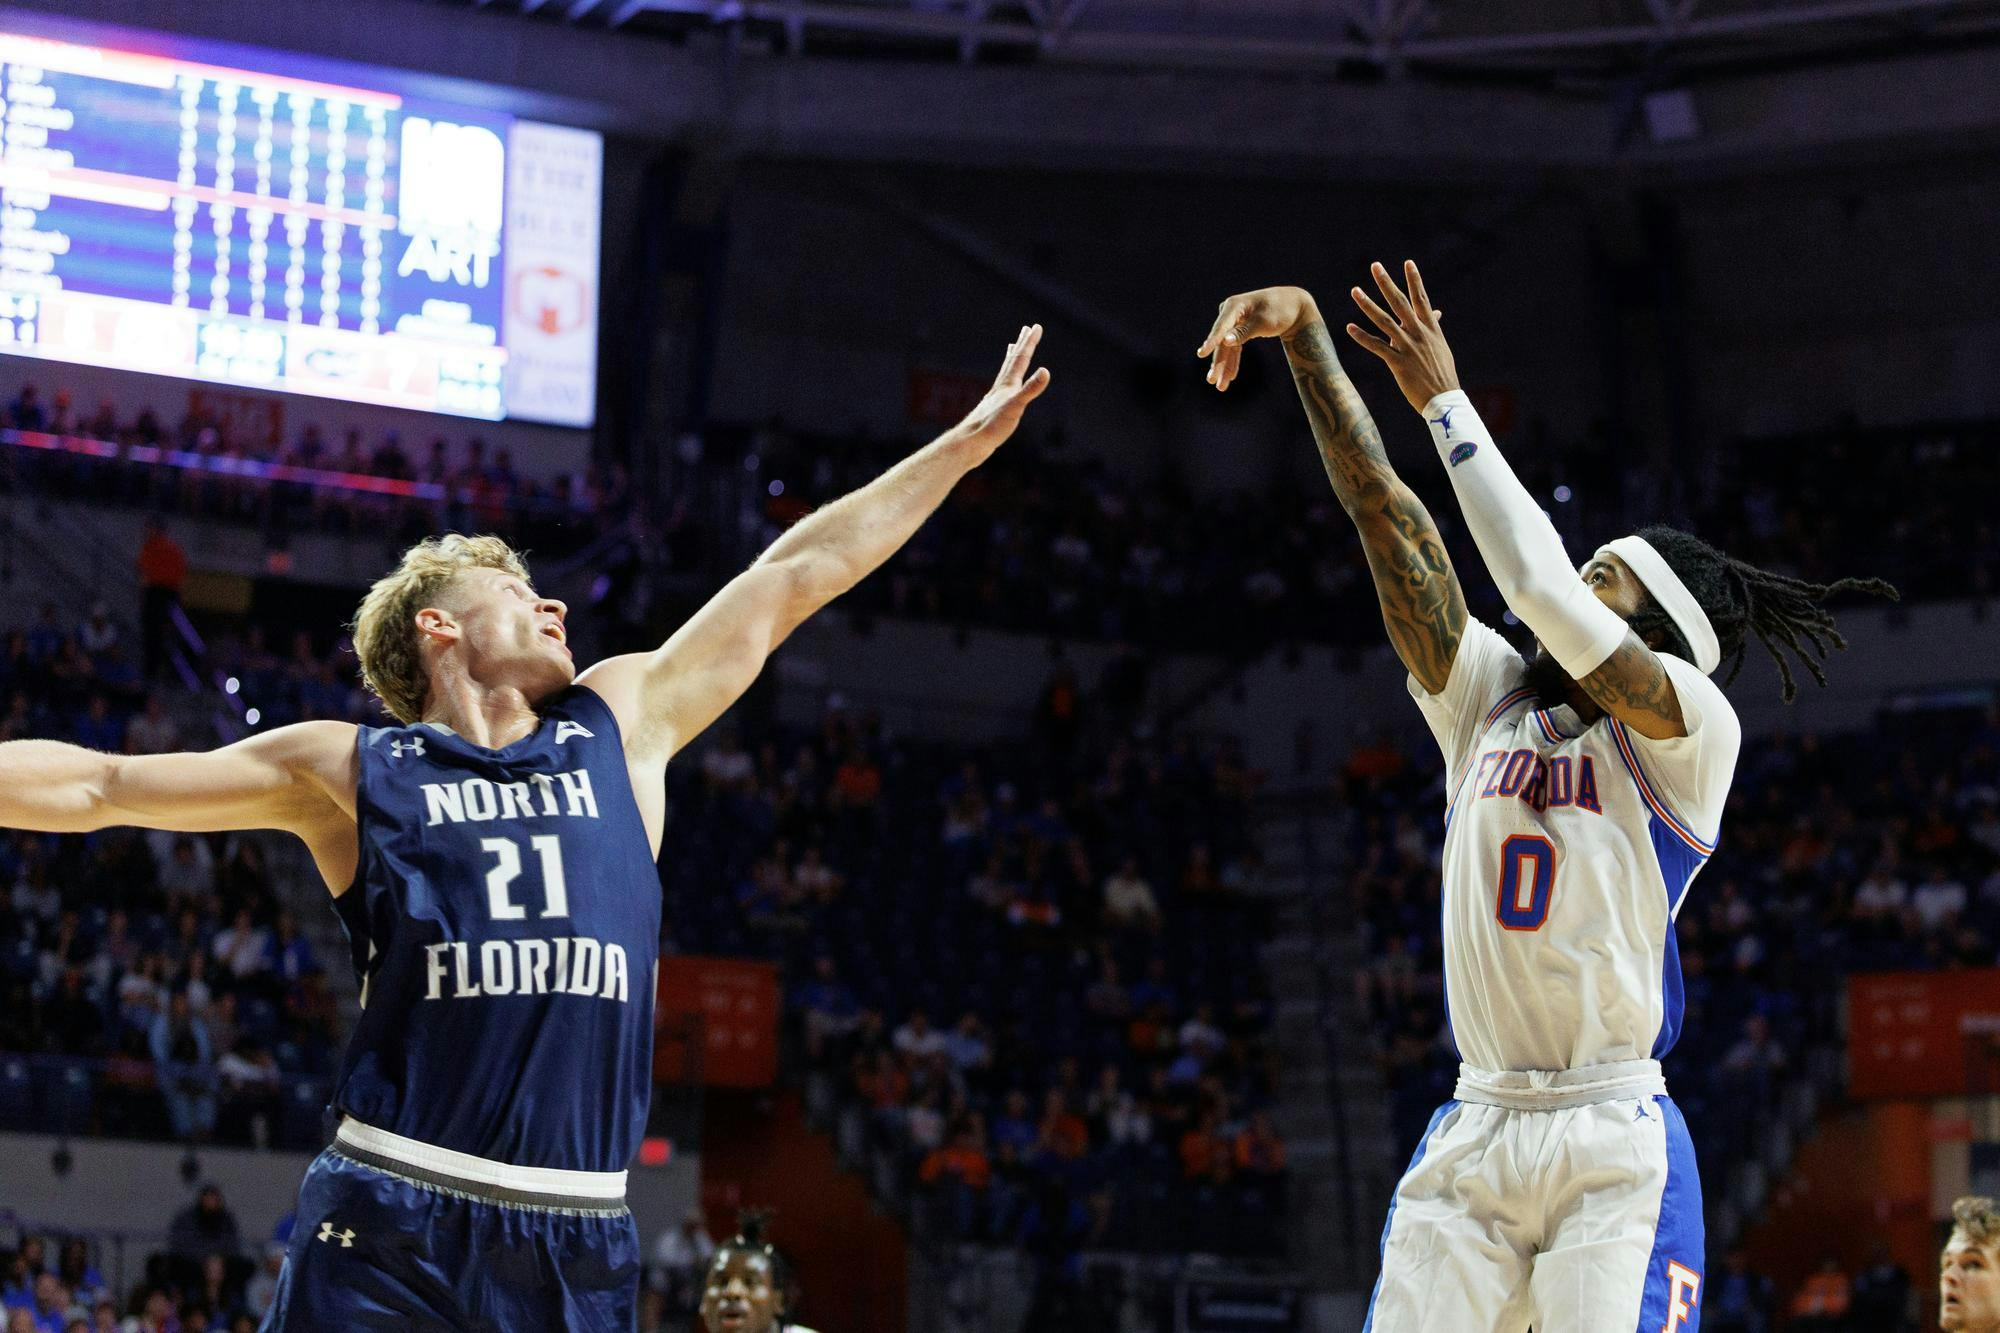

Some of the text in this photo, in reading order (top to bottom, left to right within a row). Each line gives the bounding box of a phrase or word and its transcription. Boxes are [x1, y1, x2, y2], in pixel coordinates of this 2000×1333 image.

[420, 769, 599, 826] NORTH
[481, 834, 570, 921] 21
[1496, 834, 1556, 931] 0
[424, 937, 628, 1003] FLORIDA
[1661, 1259, 1701, 1333] F
